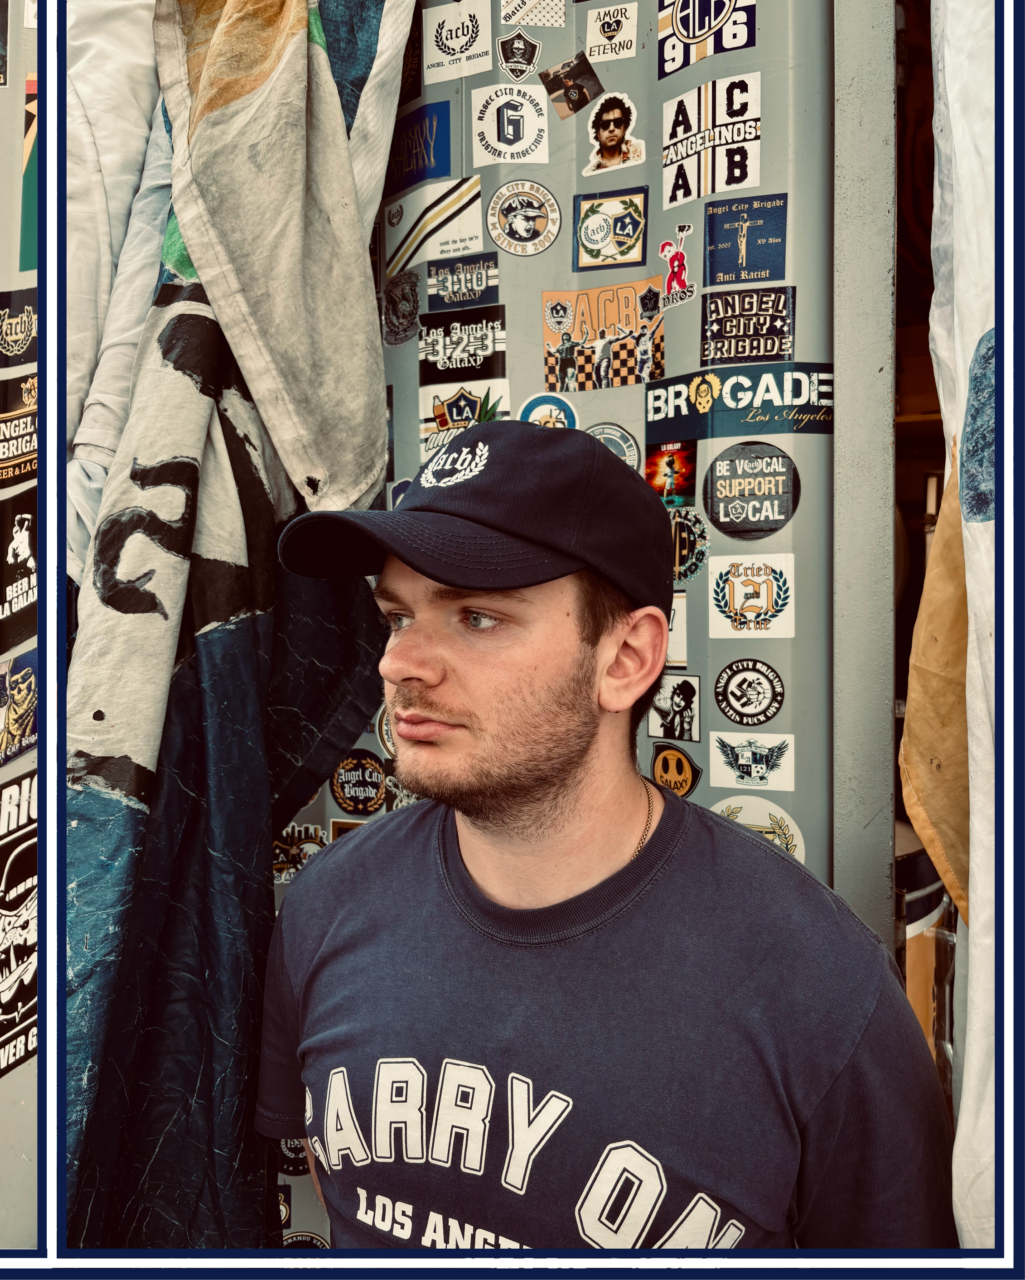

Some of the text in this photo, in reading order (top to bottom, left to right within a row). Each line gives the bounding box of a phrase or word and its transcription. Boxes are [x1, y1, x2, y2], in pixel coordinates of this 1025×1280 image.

[595, 7, 631, 23] AMOR
[445, 21, 471, 42] acb
[604, 19, 618, 32] LA
[589, 39, 634, 58] ETERNO
[427, 50, 490, 71] ANGEL CITY BRIGADE
[666, 119, 758, 166] ANGELINOS
[490, 182, 558, 218] ANGEL CITY BRIGADE
[707, 199, 785, 215] Angel City Brigade
[589, 224, 606, 238] acb
[615, 222, 633, 237] LA
[495, 229, 555, 254] SINCE 2007
[717, 242, 732, 250] 2007
[429, 260, 496, 279] Los Angeles
[715, 269, 771, 283] Anti Racist
[444, 290, 482, 304] Galaxy
[707, 292, 787, 321] ANGEL
[553, 310, 565, 318] LA
[572, 287, 637, 341] ACB
[4, 314, 27, 338] acb
[421, 320, 502, 341] Los Angeles
[722, 316, 770, 336] CITY
[701, 335, 793, 360] BRIGADE
[436, 355, 484, 371] Galaxy
[452, 406, 473, 420] LA
[549, 408, 567, 420] 121
[741, 404, 834, 431] Los Angeles
[433, 447, 473, 472] acb
[716, 460, 731, 477] BE
[716, 476, 787, 499] SUPPORT
[728, 562, 773, 579] Tried
[6, 577, 29, 602] BEER
[725, 578, 777, 615] 121
[730, 615, 771, 632] True
[716, 661, 784, 694] ANGEL CITY BRIGADE
[719, 700, 781, 725] NAZIS FUCK OFF
[6, 742, 21, 756] City
[338, 768, 384, 785] Angel City
[344, 783, 378, 800] Brigade
[357, 1186, 414, 1240] LOS
